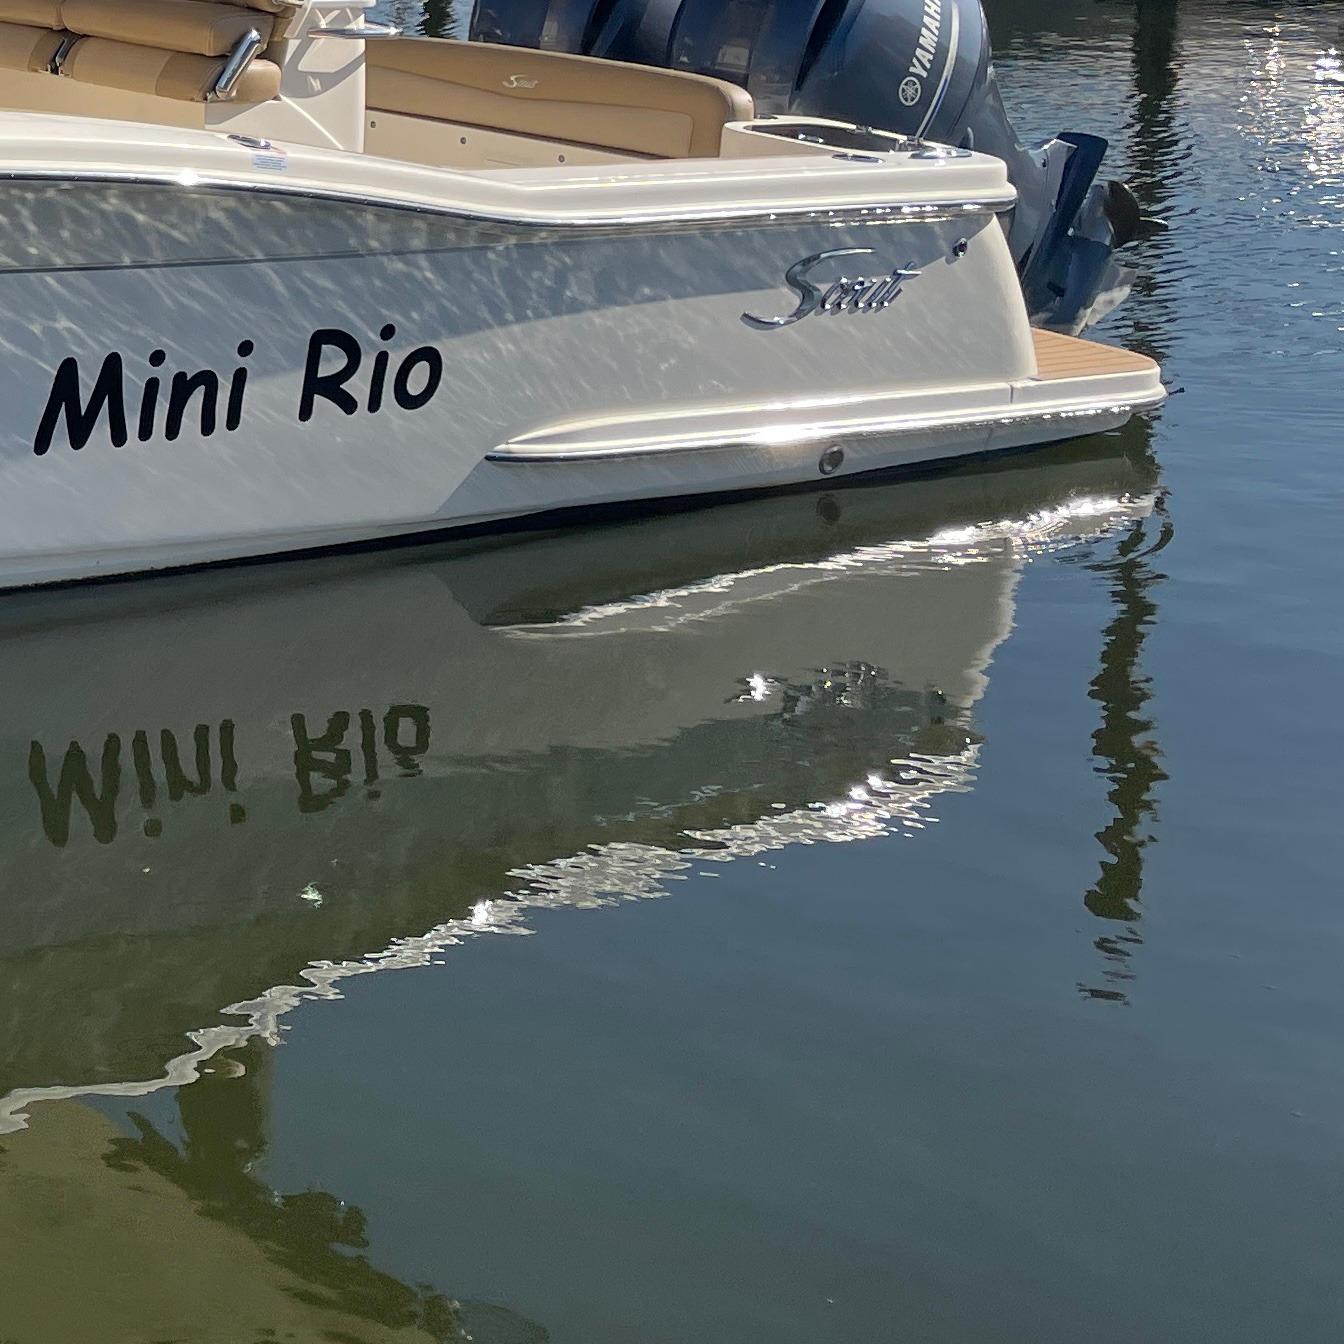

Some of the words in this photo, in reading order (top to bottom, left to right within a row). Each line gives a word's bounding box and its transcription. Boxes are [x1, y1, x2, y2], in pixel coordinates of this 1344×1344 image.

[740, 247, 923, 330] Scout
[33, 339, 255, 457] Mini
[298, 323, 444, 423] Rio
